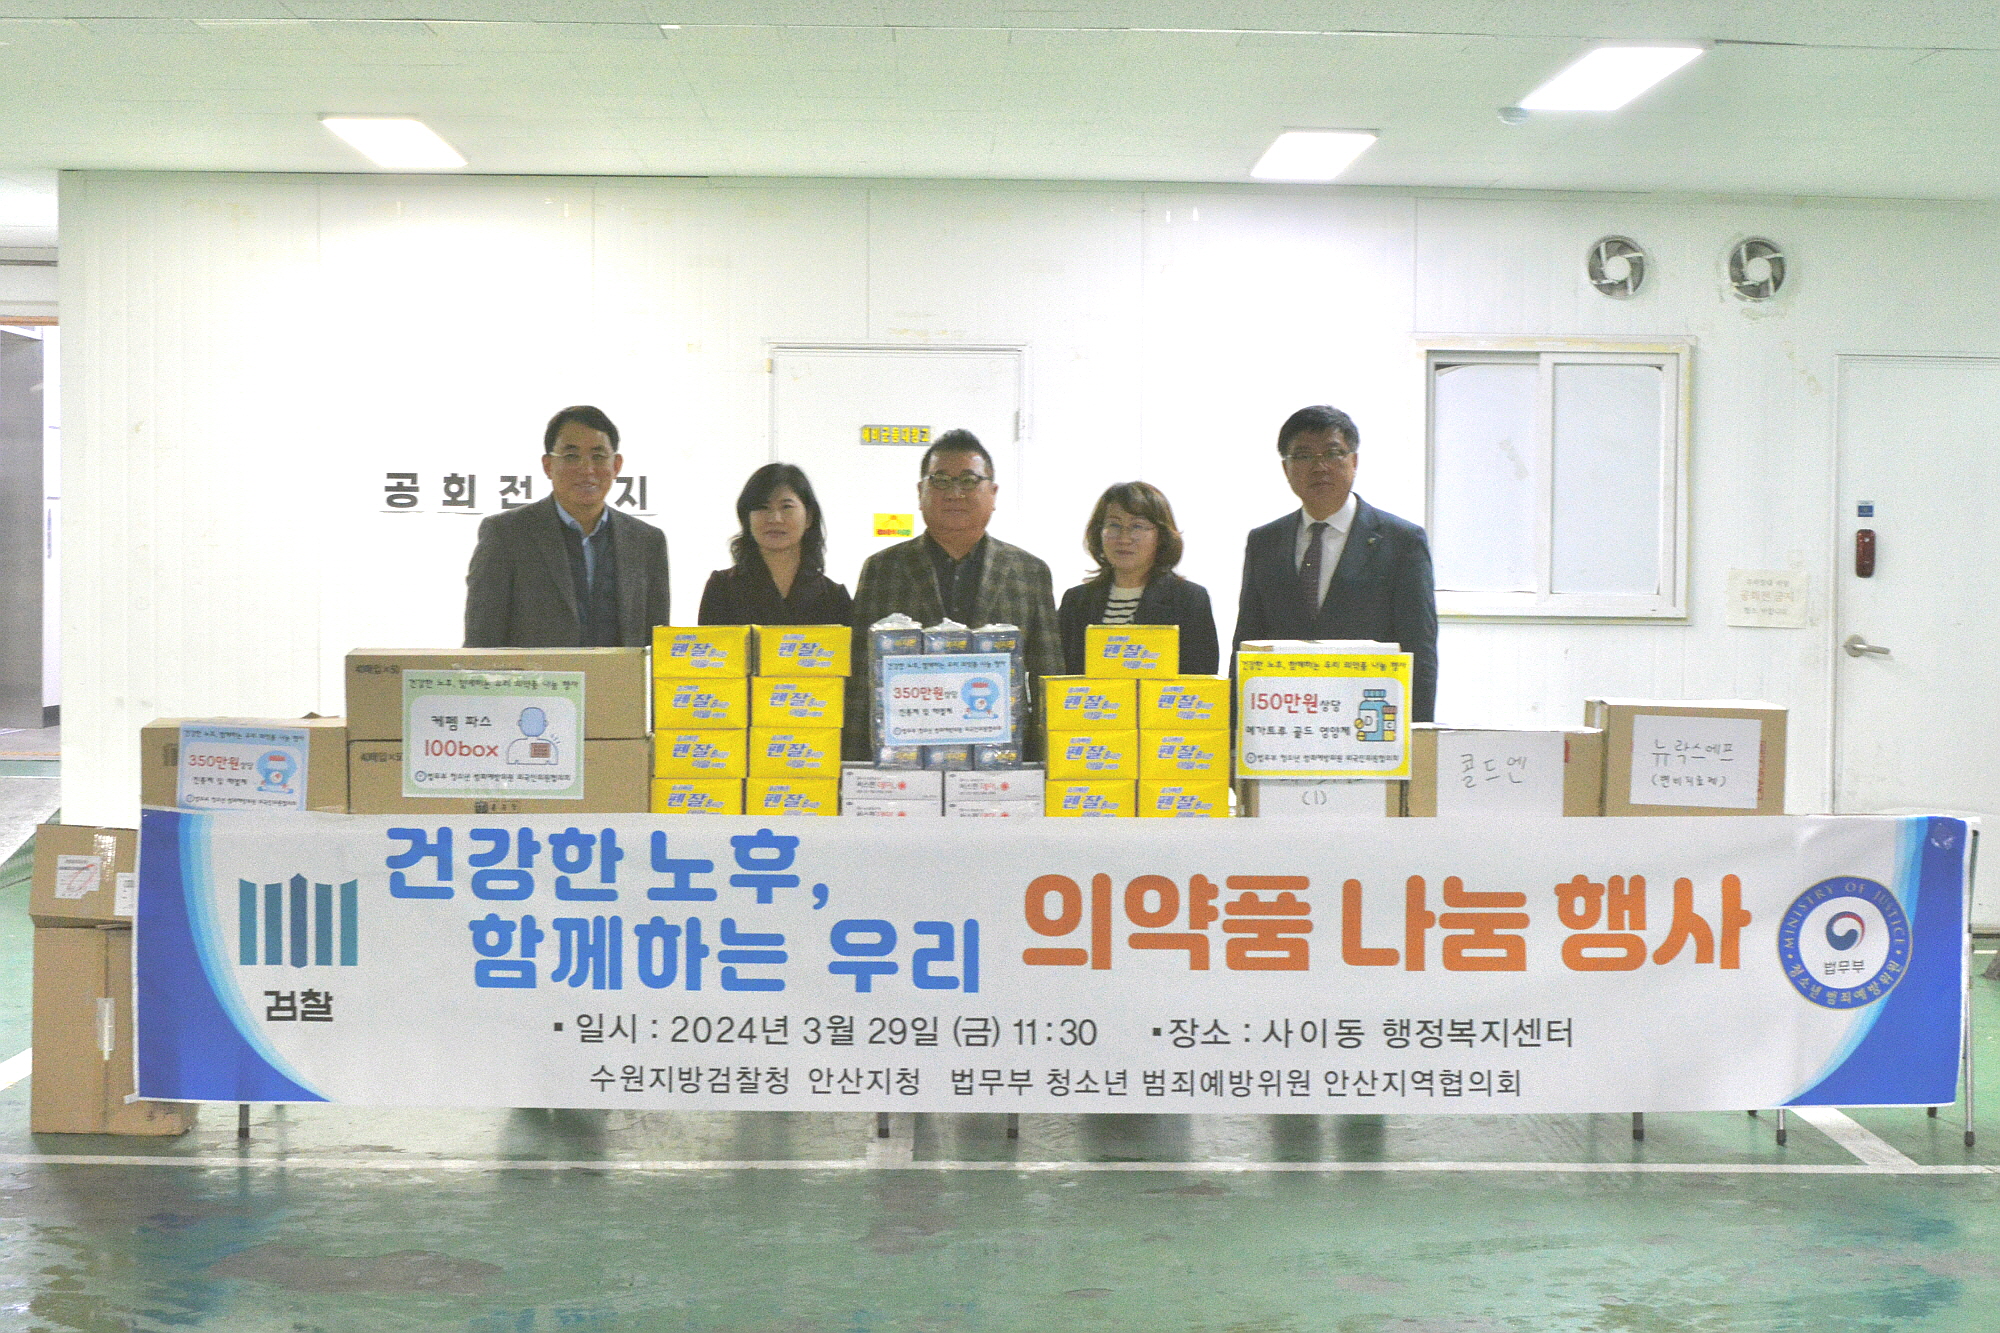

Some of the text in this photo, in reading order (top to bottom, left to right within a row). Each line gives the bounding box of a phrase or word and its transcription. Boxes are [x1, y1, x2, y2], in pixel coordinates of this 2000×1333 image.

[1251, 693, 1318, 714] 150만원
[465, 715, 492, 728] 파스
[1292, 726, 1314, 739] 골드
[1319, 726, 1350, 739] 영양제
[425, 739, 499, 757] 100box
[386, 826, 829, 910] 건강한 노후,
[1022, 873, 1752, 972] 의약품 나눔 행사
[1785, 882, 1905, 949] MINISTRY OF JUSTICE
[468, 913, 979, 993] 함께하는 우리
[1824, 960, 1865, 975] 법무부
[264, 989, 333, 1021] 검찰
[576, 1013, 637, 1043] 일시
[671, 1015, 789, 1045] 2024년
[803, 1015, 854, 1046] 3월
[868, 1016, 938, 1046] 29일
[953, 1015, 1000, 1047] (금)
[1013, 1018, 1097, 1046] 11:30
[1168, 1017, 1231, 1048] 장소
[1262, 1017, 1365, 1048] 사이동
[1382, 1017, 1573, 1048] 행정복지센터
[590, 1065, 1521, 1097] 수원지방검찰청 안산지청 법무부 청소년 범죄예방위원 안산지역협의회
